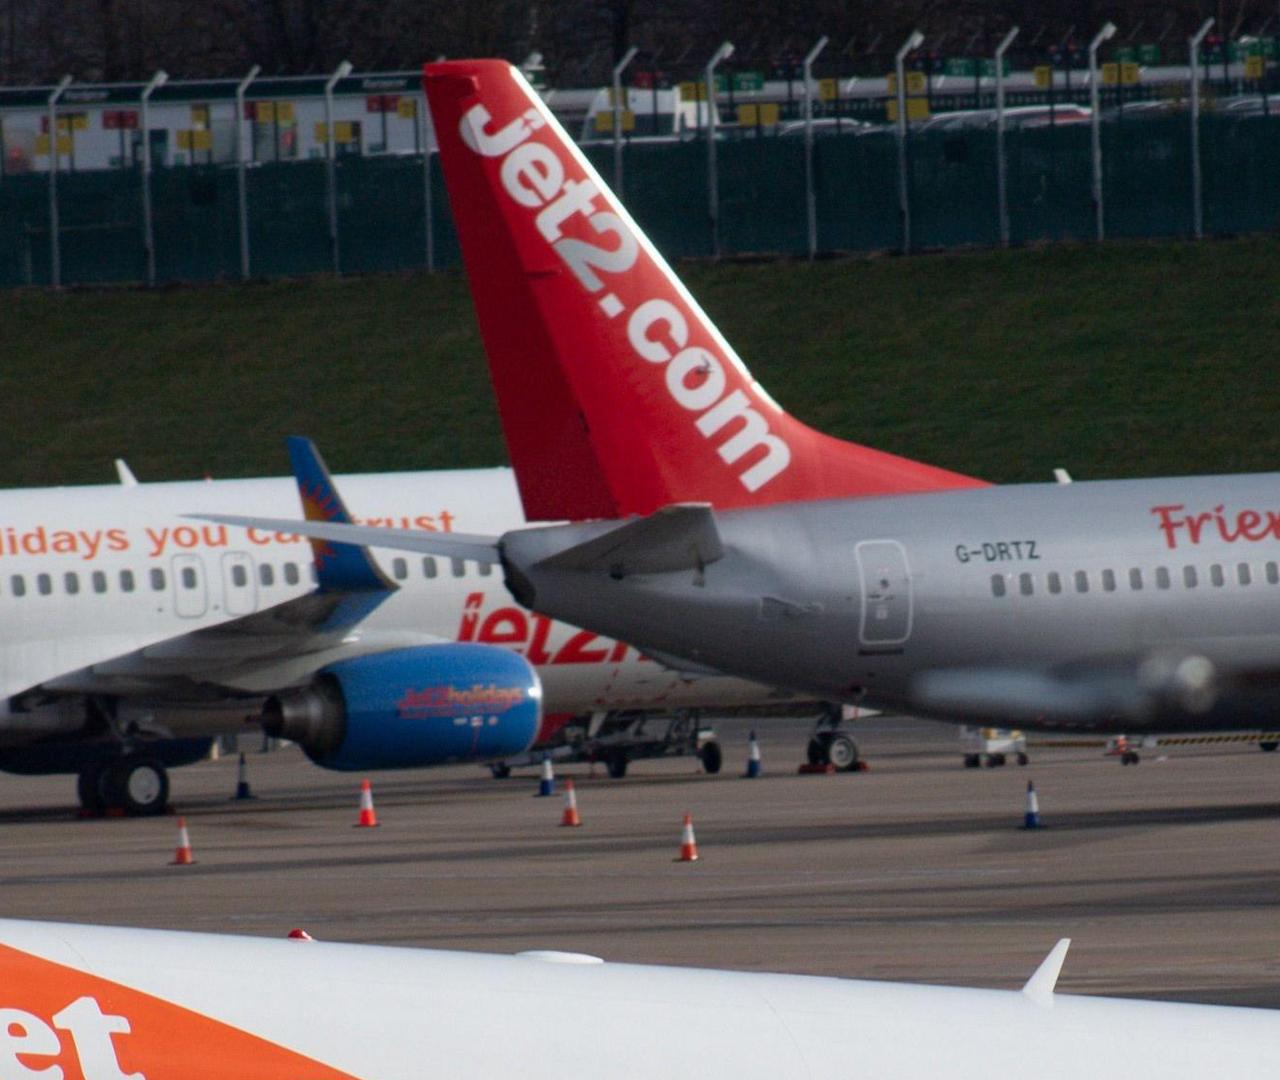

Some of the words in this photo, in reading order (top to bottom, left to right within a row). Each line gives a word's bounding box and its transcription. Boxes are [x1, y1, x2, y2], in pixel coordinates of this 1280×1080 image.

[459, 103, 792, 493] Jet2.com
[145, 523, 229, 557] you
[955, 540, 1041, 563] G-DRTZ
